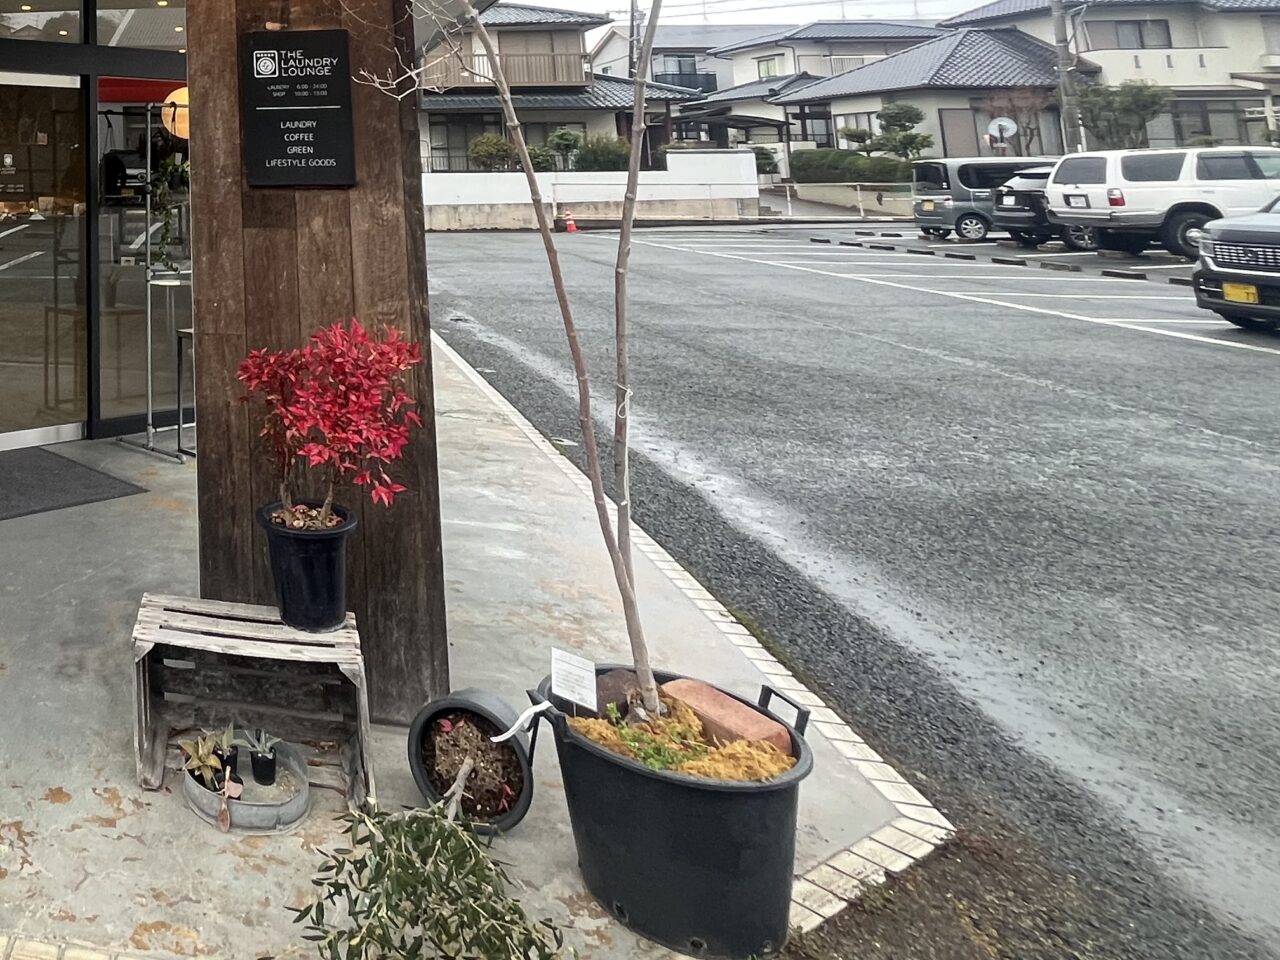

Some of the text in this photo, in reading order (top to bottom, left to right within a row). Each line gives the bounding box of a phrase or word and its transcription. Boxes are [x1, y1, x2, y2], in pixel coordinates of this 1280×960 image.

[280, 50, 303, 59] THE
[281, 58, 338, 68] LAUNDRY
[281, 67, 331, 76] LOUNGE
[281, 121, 317, 129] LAUNDRY
[284, 133, 314, 141] COFFEE
[287, 146, 313, 154] GREEN
[265, 159, 336, 167] LIFESTYLE GOODS
